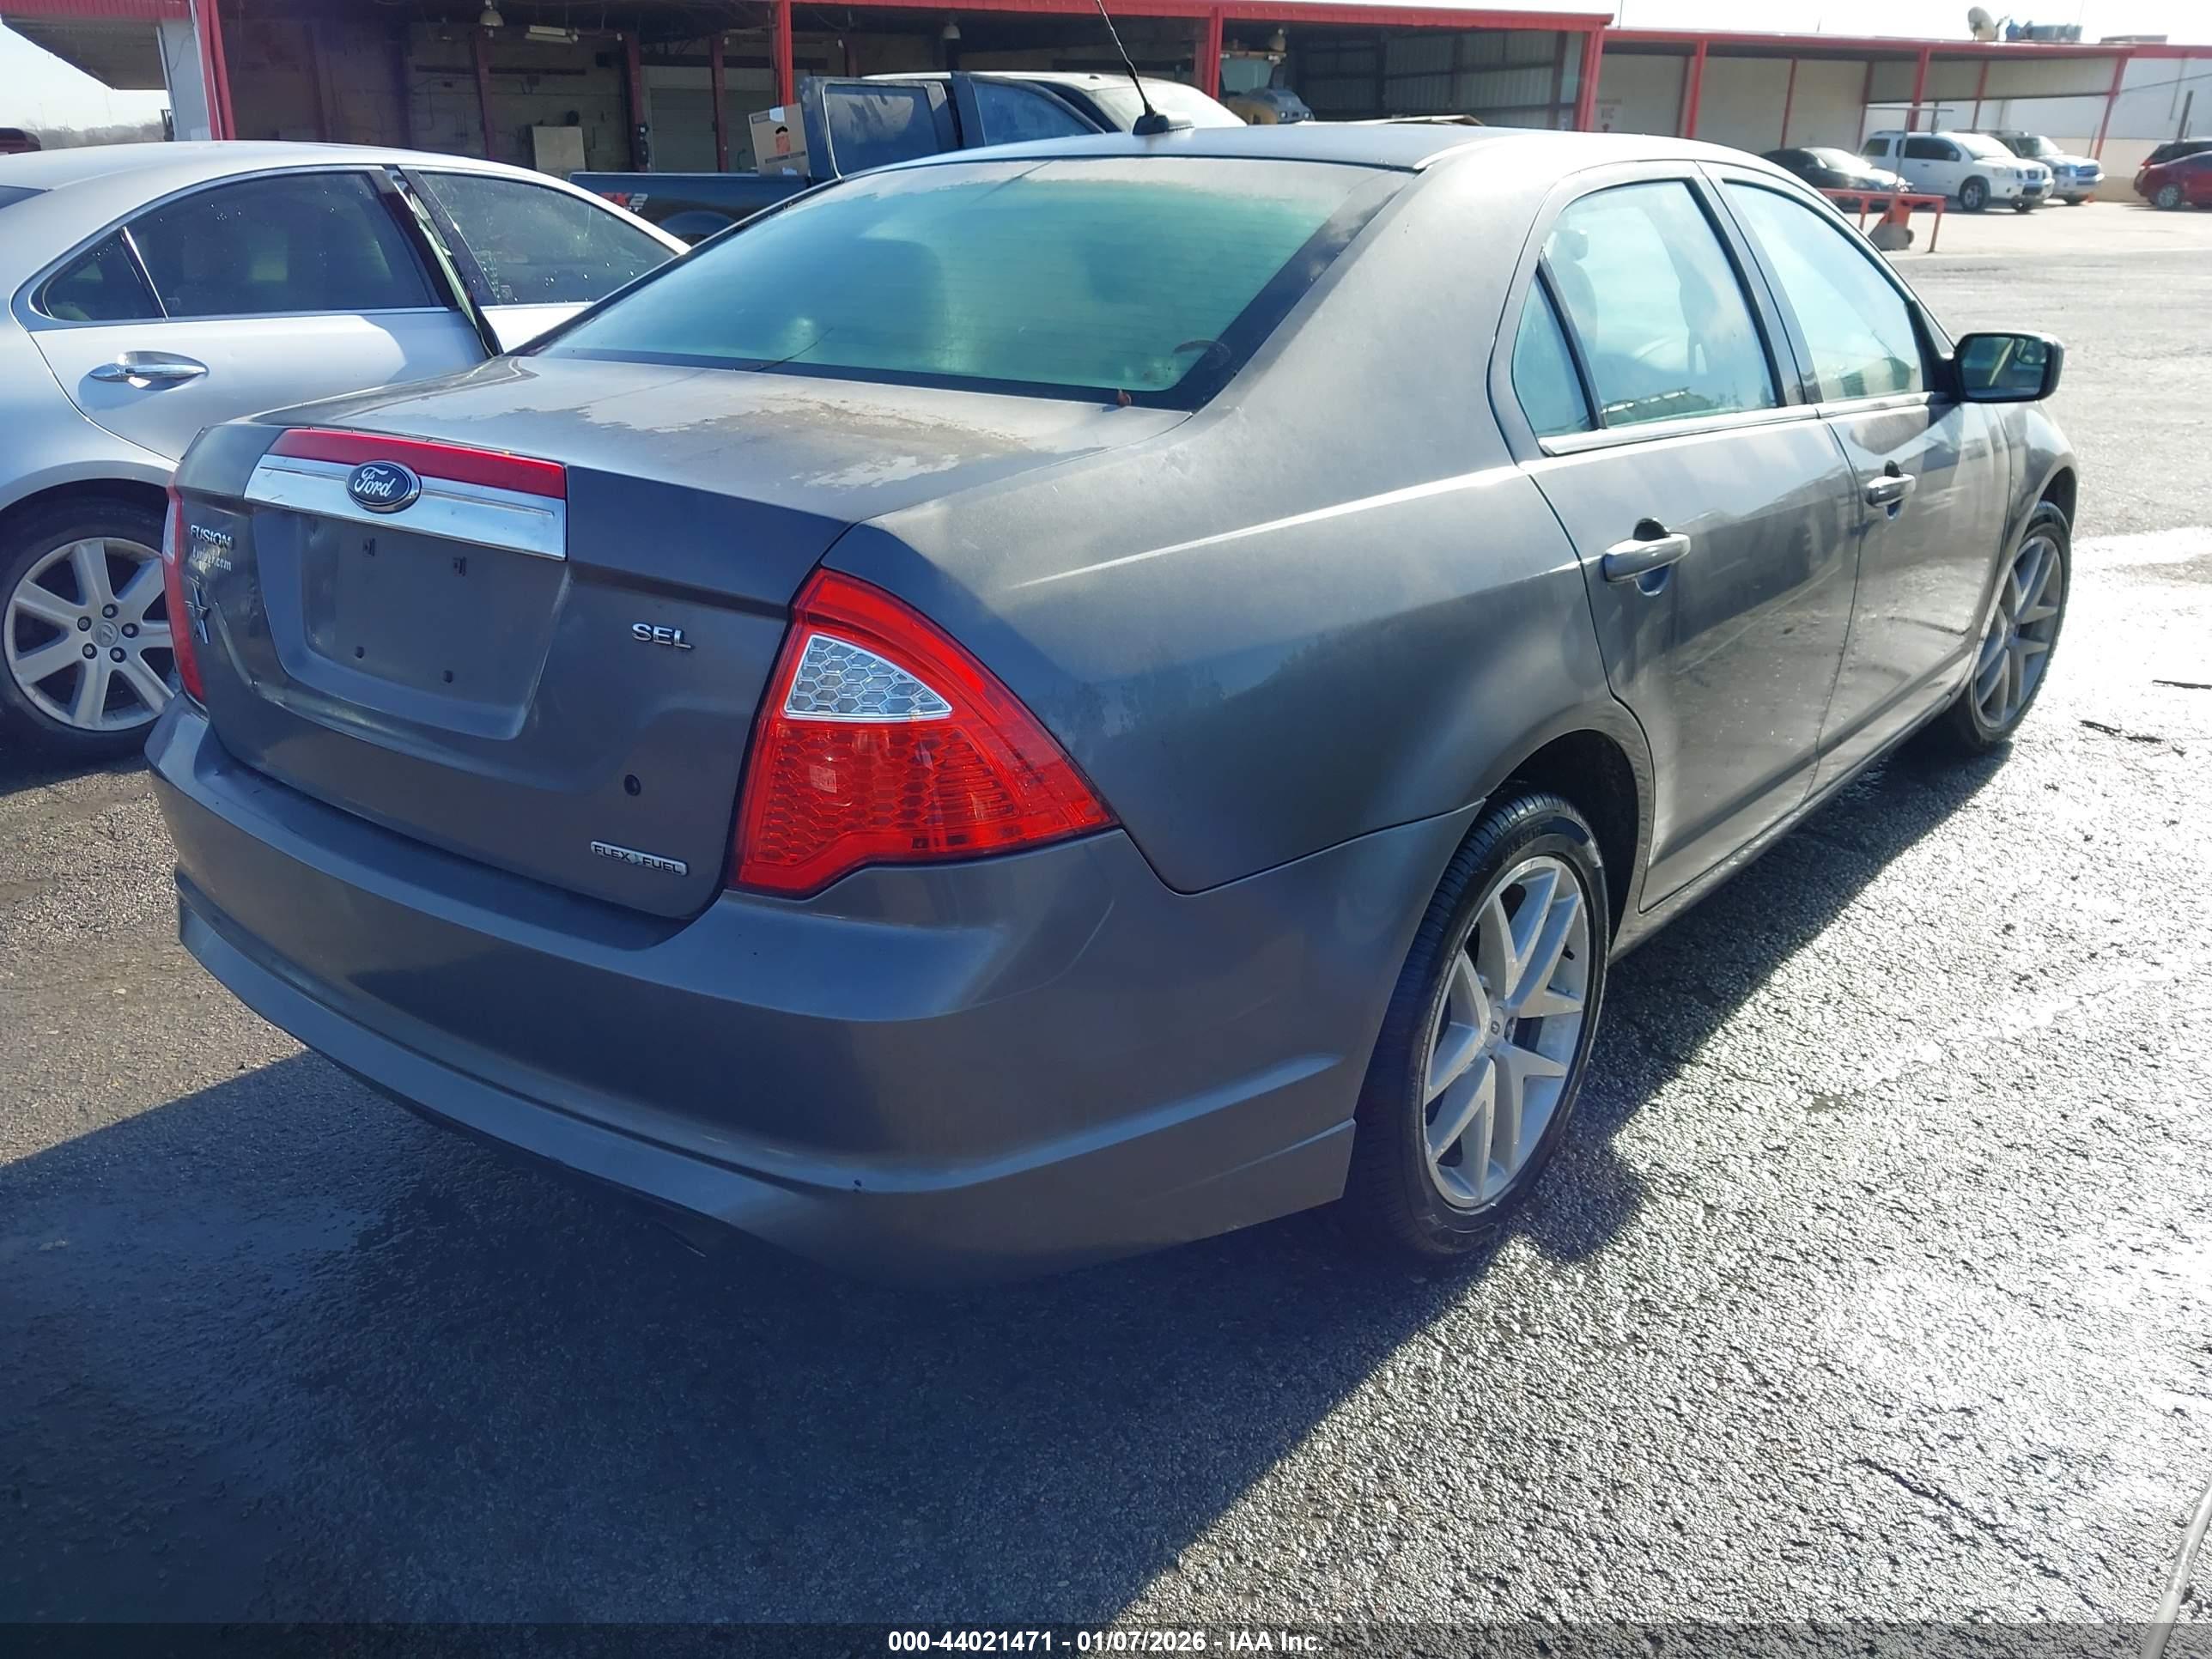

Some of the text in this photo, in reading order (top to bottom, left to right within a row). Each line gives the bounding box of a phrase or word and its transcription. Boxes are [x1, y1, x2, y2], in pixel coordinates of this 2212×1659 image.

[354, 466, 397, 497] Ford
[191, 524, 233, 549] FUSION
[632, 623, 691, 648] SEL
[594, 844, 682, 874] FLEX FUEL
